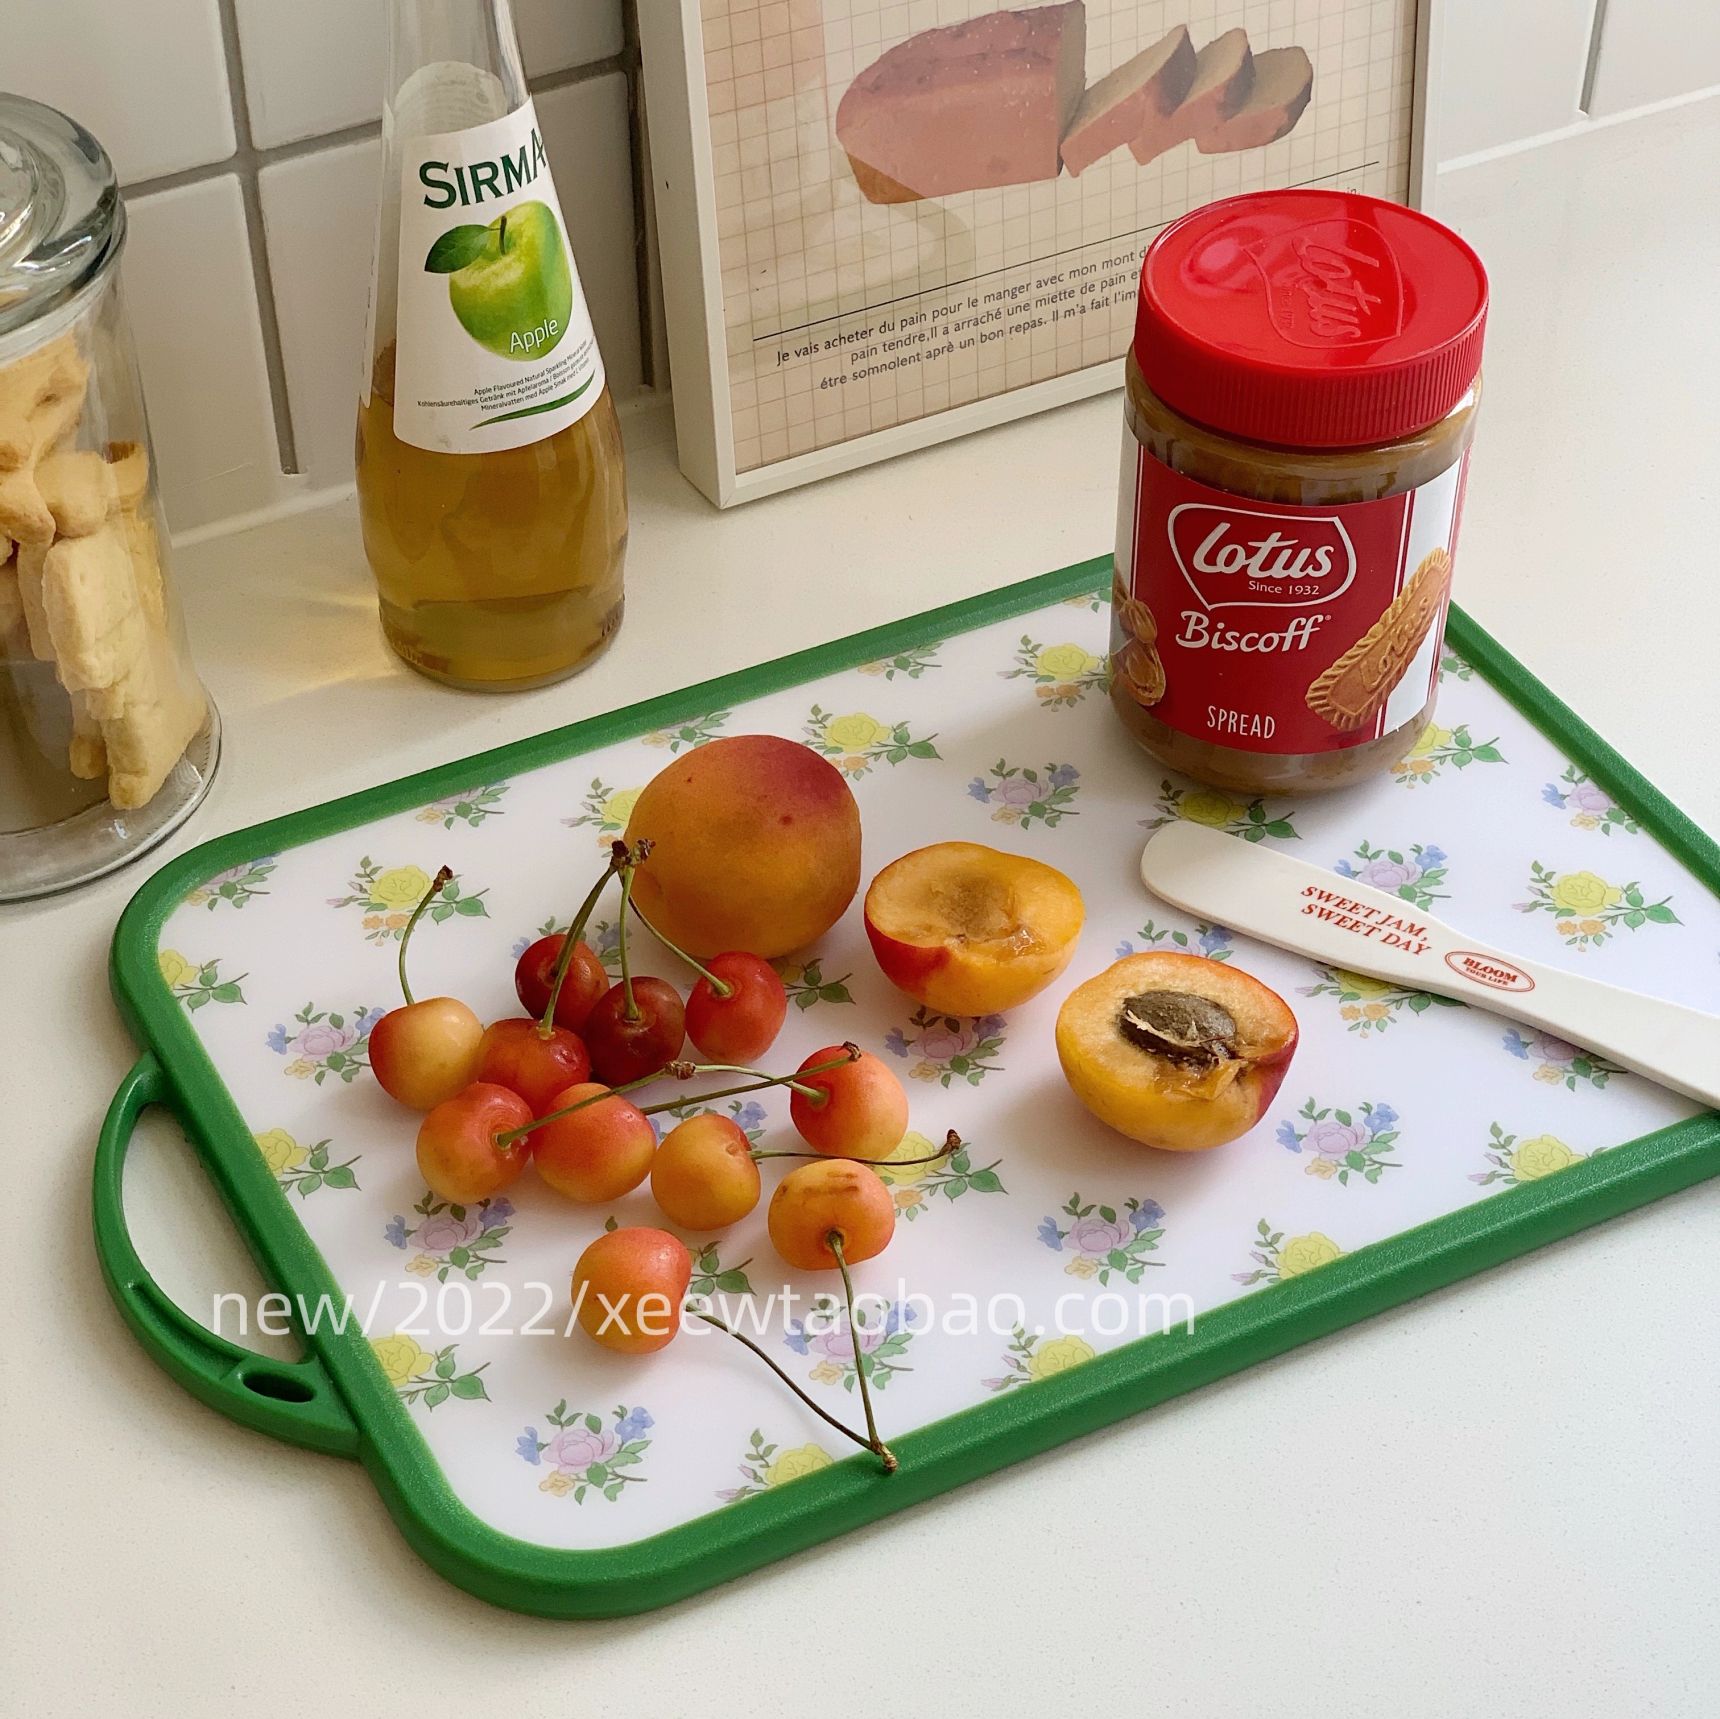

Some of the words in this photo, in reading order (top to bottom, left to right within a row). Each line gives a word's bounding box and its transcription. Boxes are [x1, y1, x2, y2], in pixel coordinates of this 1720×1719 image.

[419, 128, 546, 209] SIRMA
[777, 351, 790, 366] Je
[794, 342, 820, 358] vais
[824, 328, 875, 350] acheter
[879, 321, 895, 335] du
[900, 312, 927, 331] pain
[932, 302, 963, 322] pour
[967, 297, 978, 309] le
[983, 282, 1031, 304] manger
[1036, 272, 1065, 289] avec
[1069, 264, 1097, 280] mon
[1101, 250, 1135, 270] mont
[851, 345, 877, 365] pain
[942, 326, 949, 336] a
[954, 310, 1002, 332] arraché
[1007, 302, 1031, 317] une
[1035, 288, 1076, 309] miette
[1080, 282, 1096, 295] de
[1100, 272, 1126, 293] pain
[508, 318, 560, 354] Apple
[852, 352, 922, 381] somnolent
[926, 341, 954, 361] aprè
[959, 336, 975, 349] un
[980, 329, 1004, 344] bon
[1009, 317, 1047, 335] repas.
[1064, 304, 1086, 319] m'a
[1091, 297, 1110, 311] fait
[474, 386, 492, 395] Apple
[493, 378, 523, 392] Flavoured
[524, 370, 545, 383] Natural
[545, 358, 567, 374] Sparkling
[505, 389, 516, 397] mit
[524, 391, 537, 400] med
[1193, 522, 1334, 579] Lotus
[1248, 580, 1282, 594] Since
[1288, 585, 1320, 595] 1932
[1207, 706, 1275, 739] SPREAD
[1301, 886, 1381, 919] SWEET
[1376, 914, 1428, 941] JAM,
[1301, 903, 1382, 937] SWEET
[1380, 932, 1432, 955] DAY
[1463, 957, 1518, 982] BLOOM
[1488, 976, 1508, 985] LIFE
